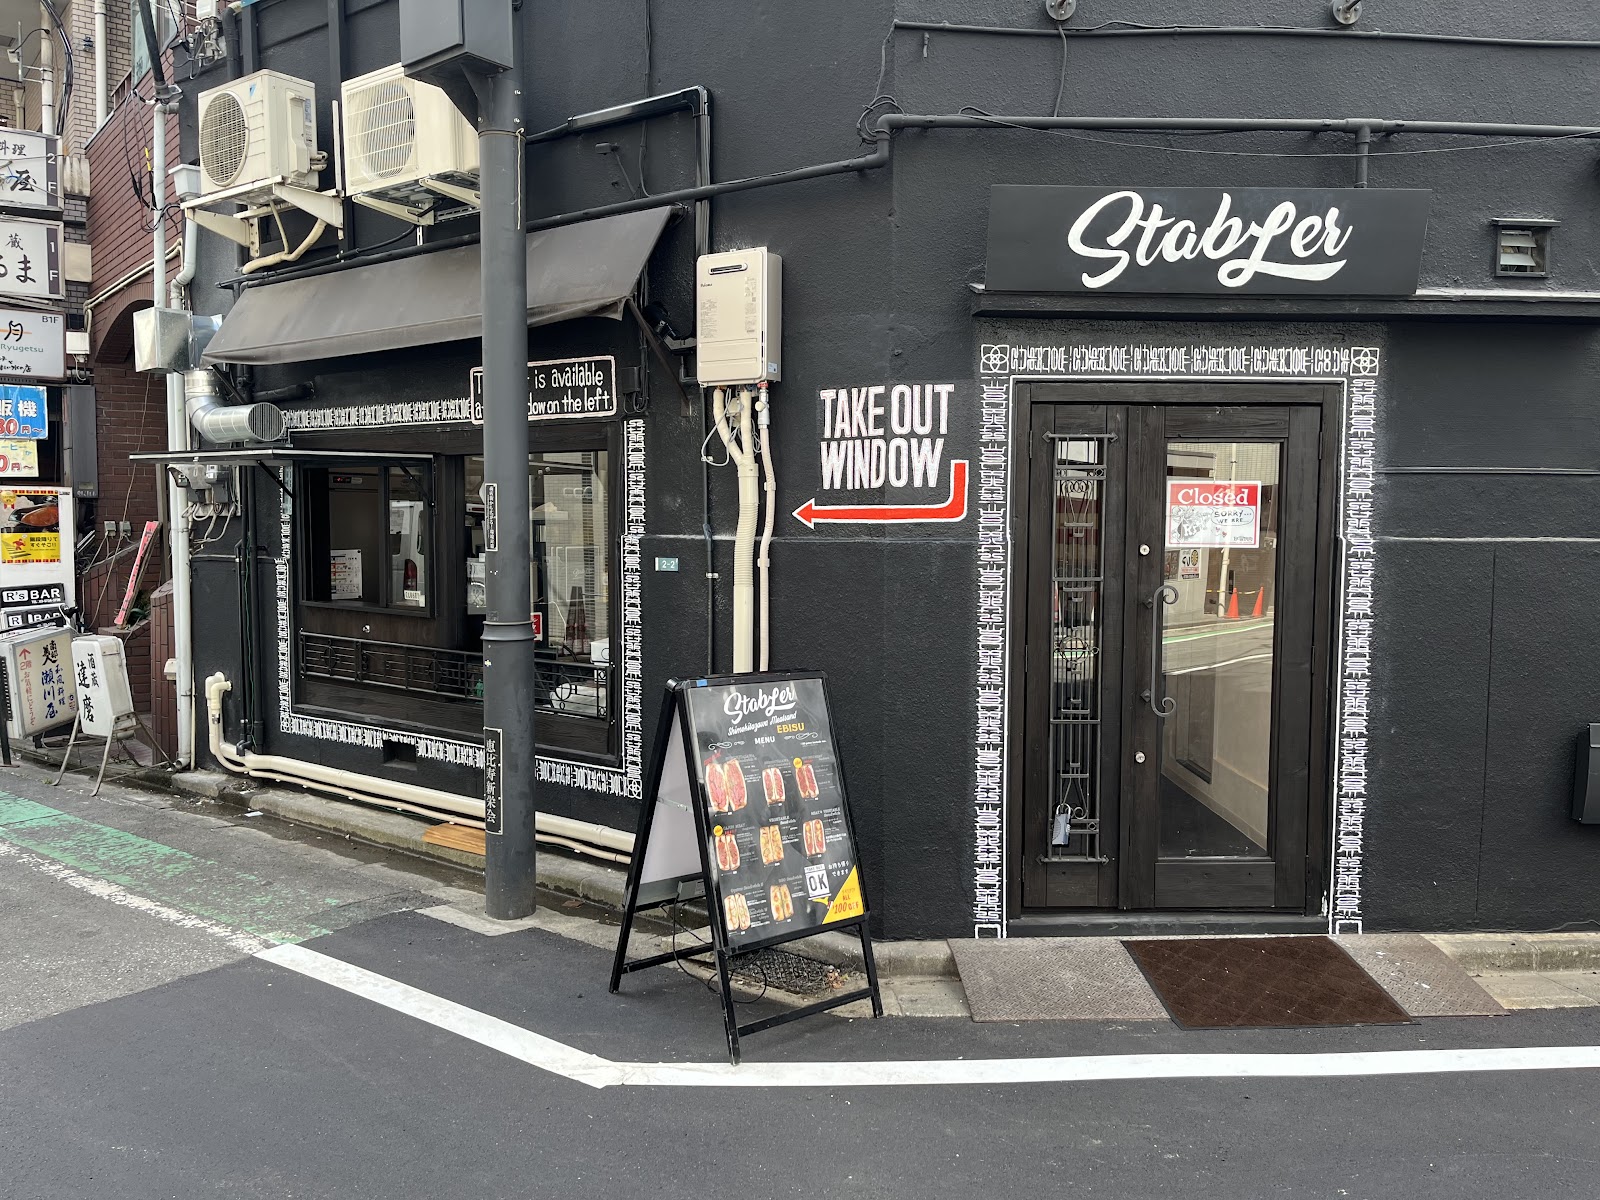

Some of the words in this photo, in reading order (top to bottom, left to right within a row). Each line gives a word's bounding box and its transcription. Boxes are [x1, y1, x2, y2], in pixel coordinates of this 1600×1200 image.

[42, 315, 59, 324] B1F
[0, 343, 44, 353] Ryugetsu
[534, 369, 546, 389] is
[551, 362, 604, 388] available
[528, 392, 545, 415] dow
[546, 401, 560, 414] on
[562, 388, 582, 412] the
[820, 385, 885, 439] TAKE
[890, 384, 955, 436] OUT
[820, 438, 945, 490] WINDOW
[1177, 488, 1249, 505] Closed
[661, 559, 675, 569] 2-2
[6, 591, 25, 601] R's
[30, 588, 61, 600] BAR
[777, 723, 805, 733] EBISU
[754, 736, 775, 745] MENU
[486, 739, 497, 824] 恵比寿新栄会
[808, 873, 828, 892] OK
